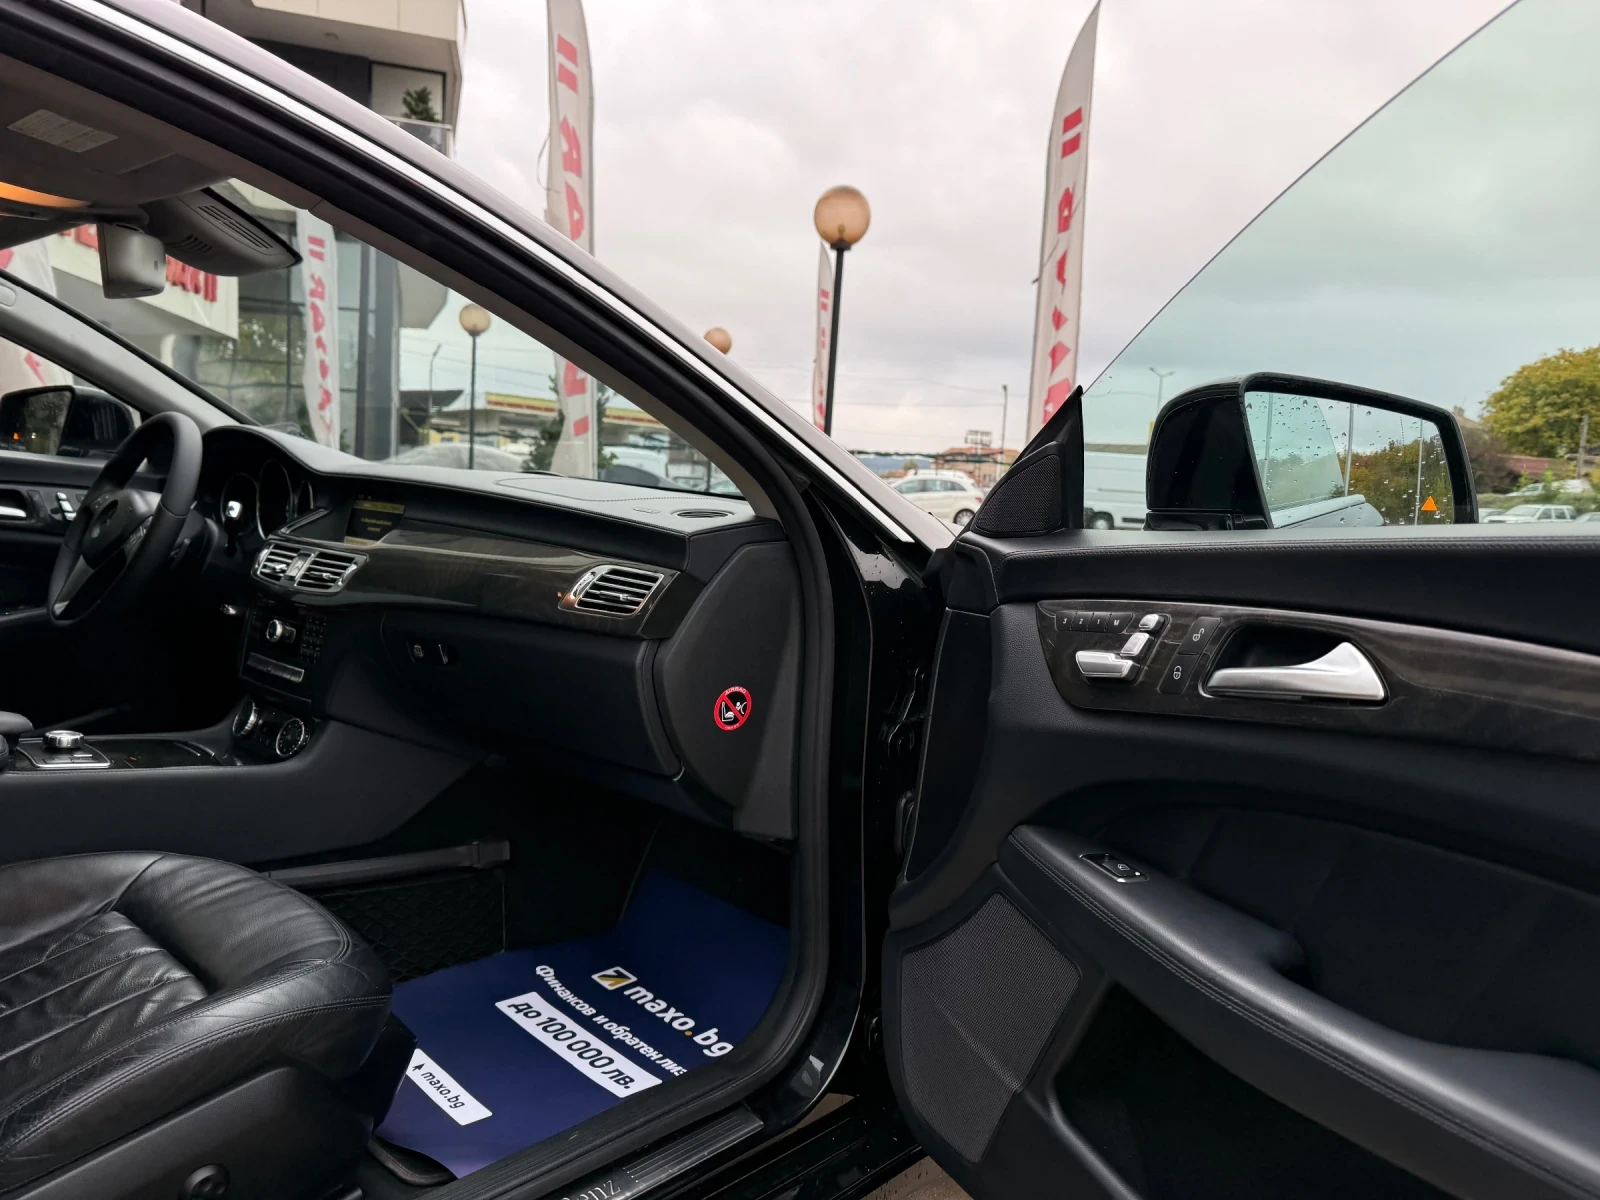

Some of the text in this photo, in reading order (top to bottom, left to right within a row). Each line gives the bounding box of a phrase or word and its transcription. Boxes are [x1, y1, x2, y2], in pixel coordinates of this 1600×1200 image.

[535, 964, 597, 1016] Финансов
[592, 1015, 610, 1025] и
[603, 1021, 664, 1062] обратен
[535, 1016, 577, 1042] 100
[566, 1040, 615, 1069] 000
[623, 986, 734, 1057] maxo.bg
[420, 1071, 465, 1109] maxo.bg
